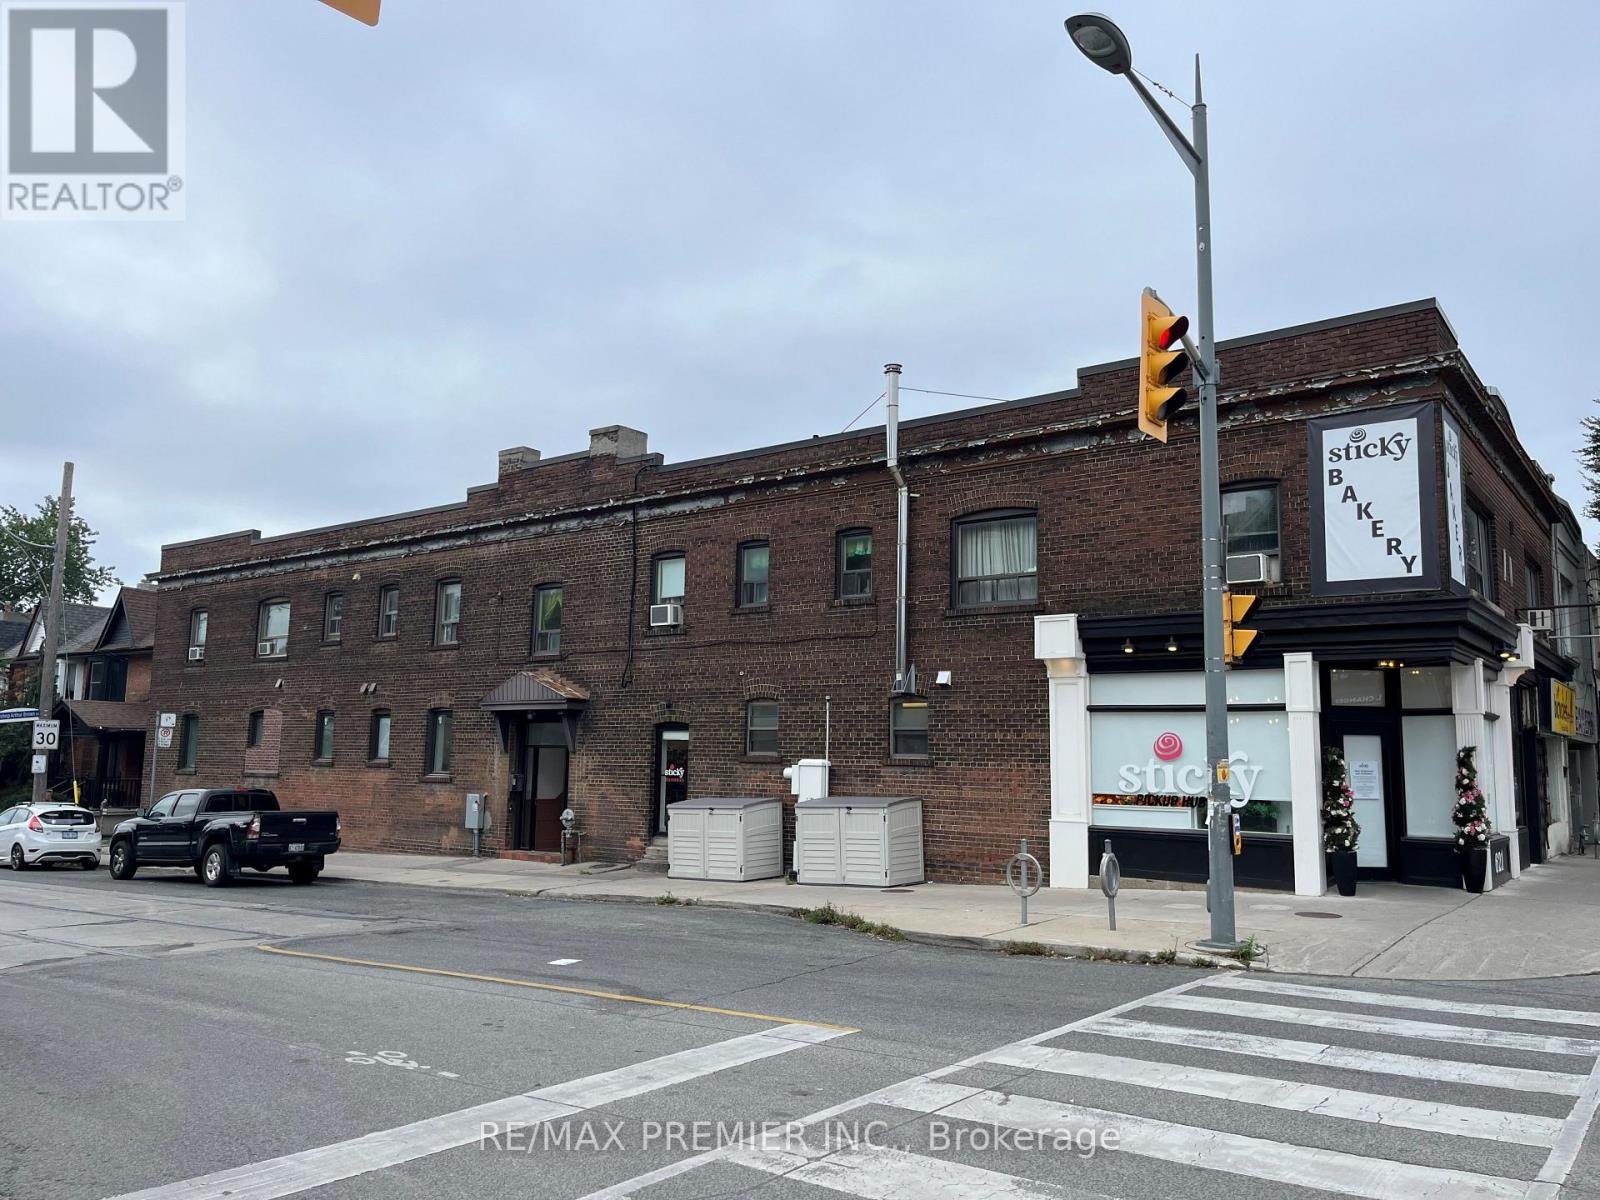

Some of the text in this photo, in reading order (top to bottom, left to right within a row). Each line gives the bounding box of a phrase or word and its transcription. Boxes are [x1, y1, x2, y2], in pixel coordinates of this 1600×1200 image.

[1328, 429, 1411, 462] sticky
[1328, 468, 1417, 573] BAKERY
[35, 732, 56, 745] 30
